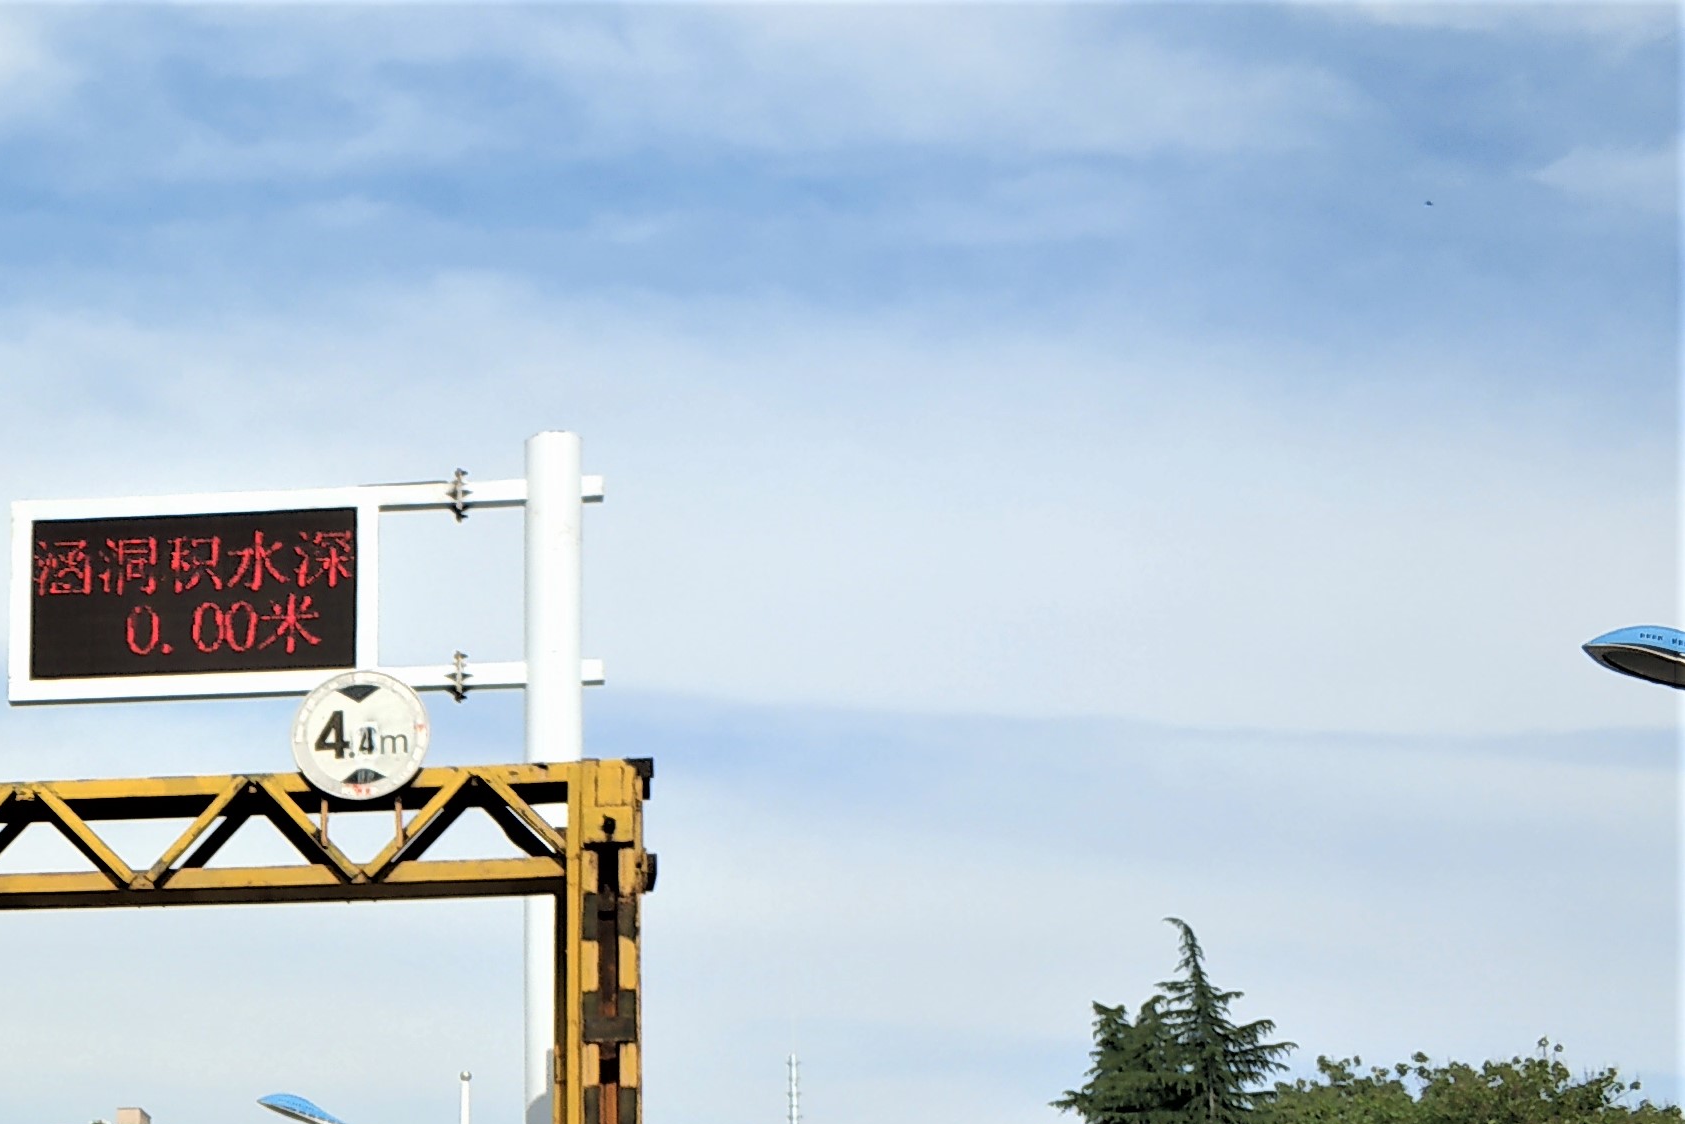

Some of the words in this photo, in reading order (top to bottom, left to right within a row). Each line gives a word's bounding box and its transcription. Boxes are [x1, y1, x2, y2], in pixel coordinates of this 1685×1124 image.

[32, 529, 354, 597] 涵洞积水深
